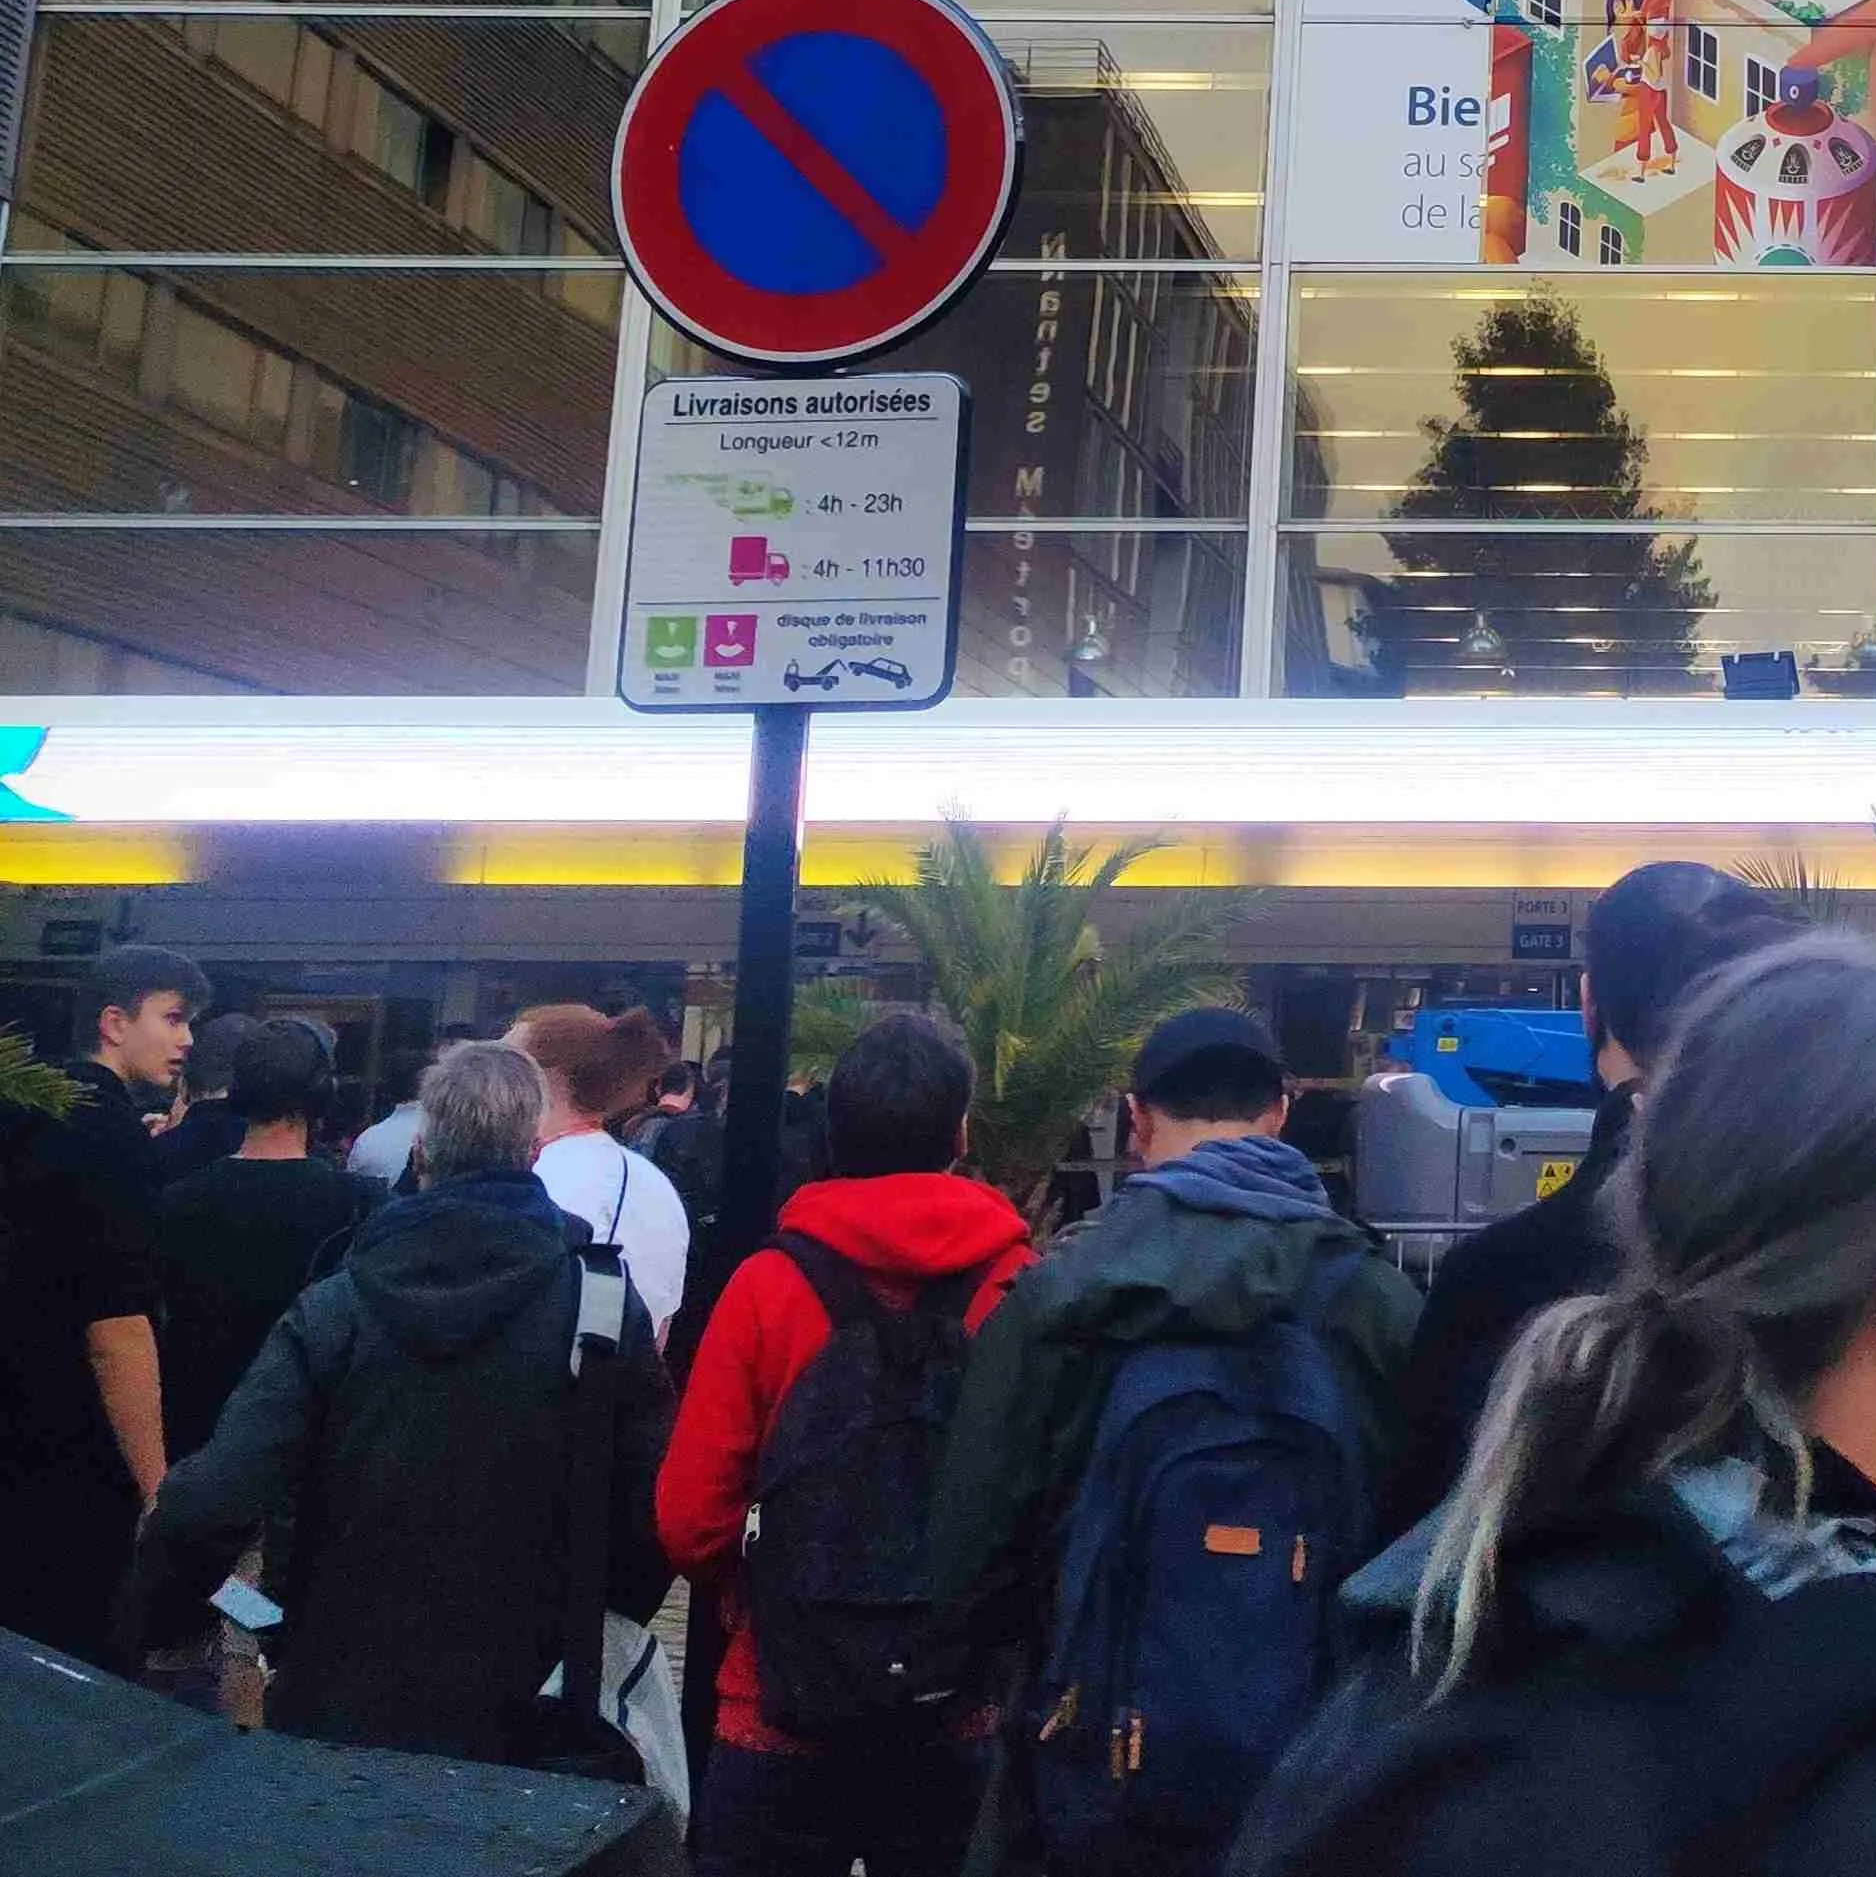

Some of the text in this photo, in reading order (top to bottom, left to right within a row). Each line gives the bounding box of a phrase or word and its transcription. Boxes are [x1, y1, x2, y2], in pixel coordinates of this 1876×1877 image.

[1408, 86, 1481, 126] Bie
[1403, 152, 1446, 177] au
[1402, 194, 1447, 229] de
[673, 388, 931, 417] Livraisons autorisées
[720, 432, 814, 454] Longueur
[817, 494, 843, 513] 4h
[864, 493, 903, 513] 23h
[813, 560, 839, 577] 4h
[863, 558, 925, 576] 11h30
[776, 612, 928, 629] disque de livraison
[808, 634, 894, 650] obligatoire
[1518, 900, 1568, 915] PORTE 3
[1520, 934, 1553, 949] GATE
